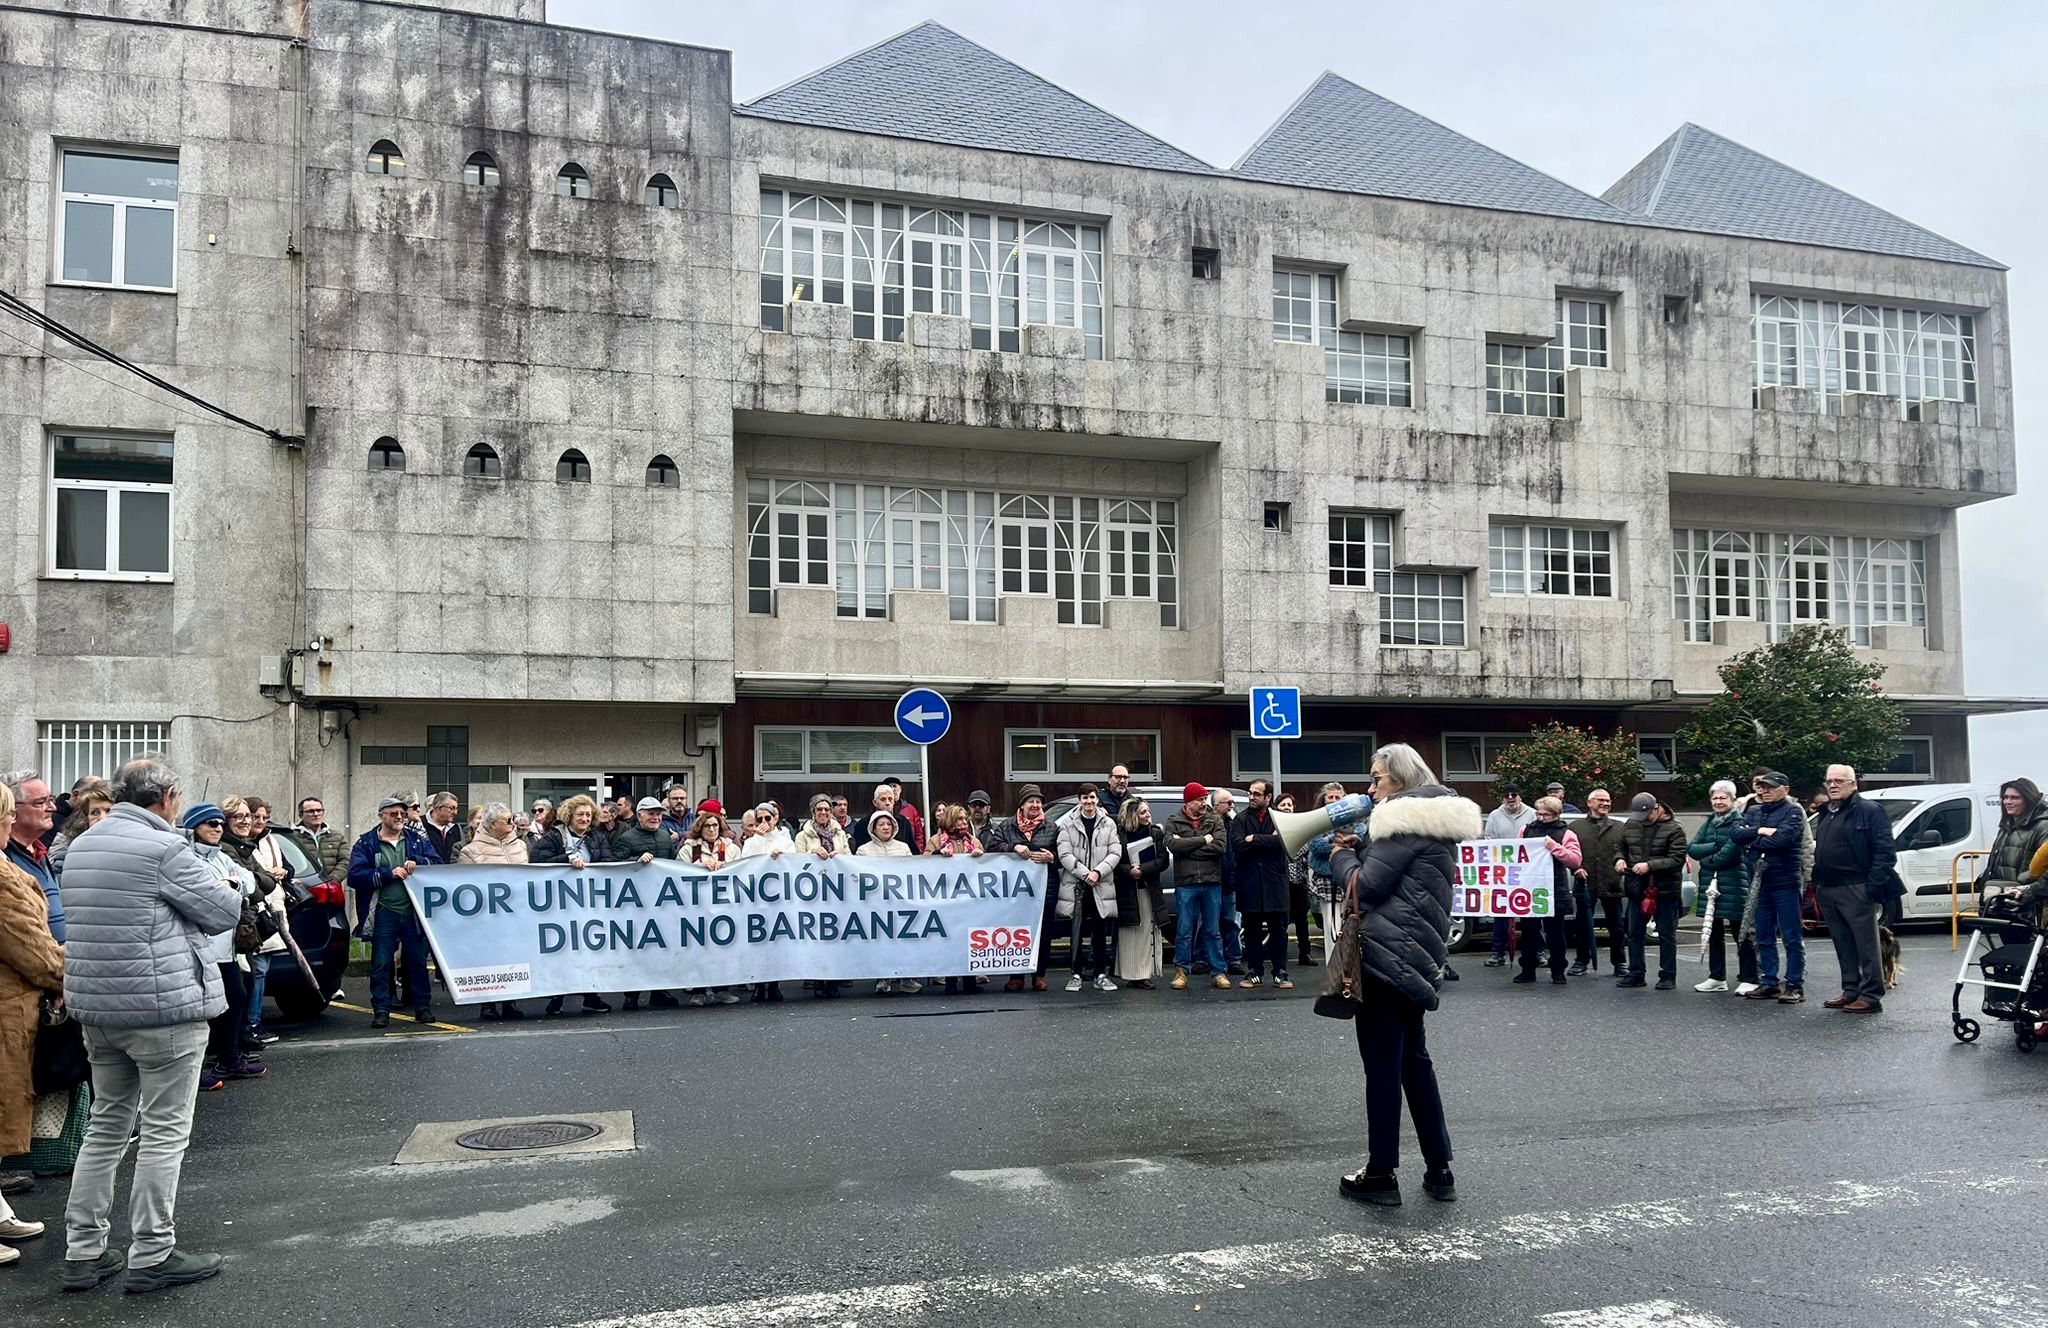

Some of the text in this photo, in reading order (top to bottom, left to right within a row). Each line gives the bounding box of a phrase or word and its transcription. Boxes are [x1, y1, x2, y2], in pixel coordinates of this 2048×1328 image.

[423, 863, 1035, 919] POR UNHA ATENCIÓN PRIMARIA
[1452, 885, 1549, 915] ÉDIC@S
[538, 910, 948, 954] DIGNA NO BARBANZA
[970, 927, 1031, 949] SOS
[970, 946, 1031, 958] sanidade
[970, 957, 1031, 971] pública
[459, 985, 506, 993] BARBANZA
